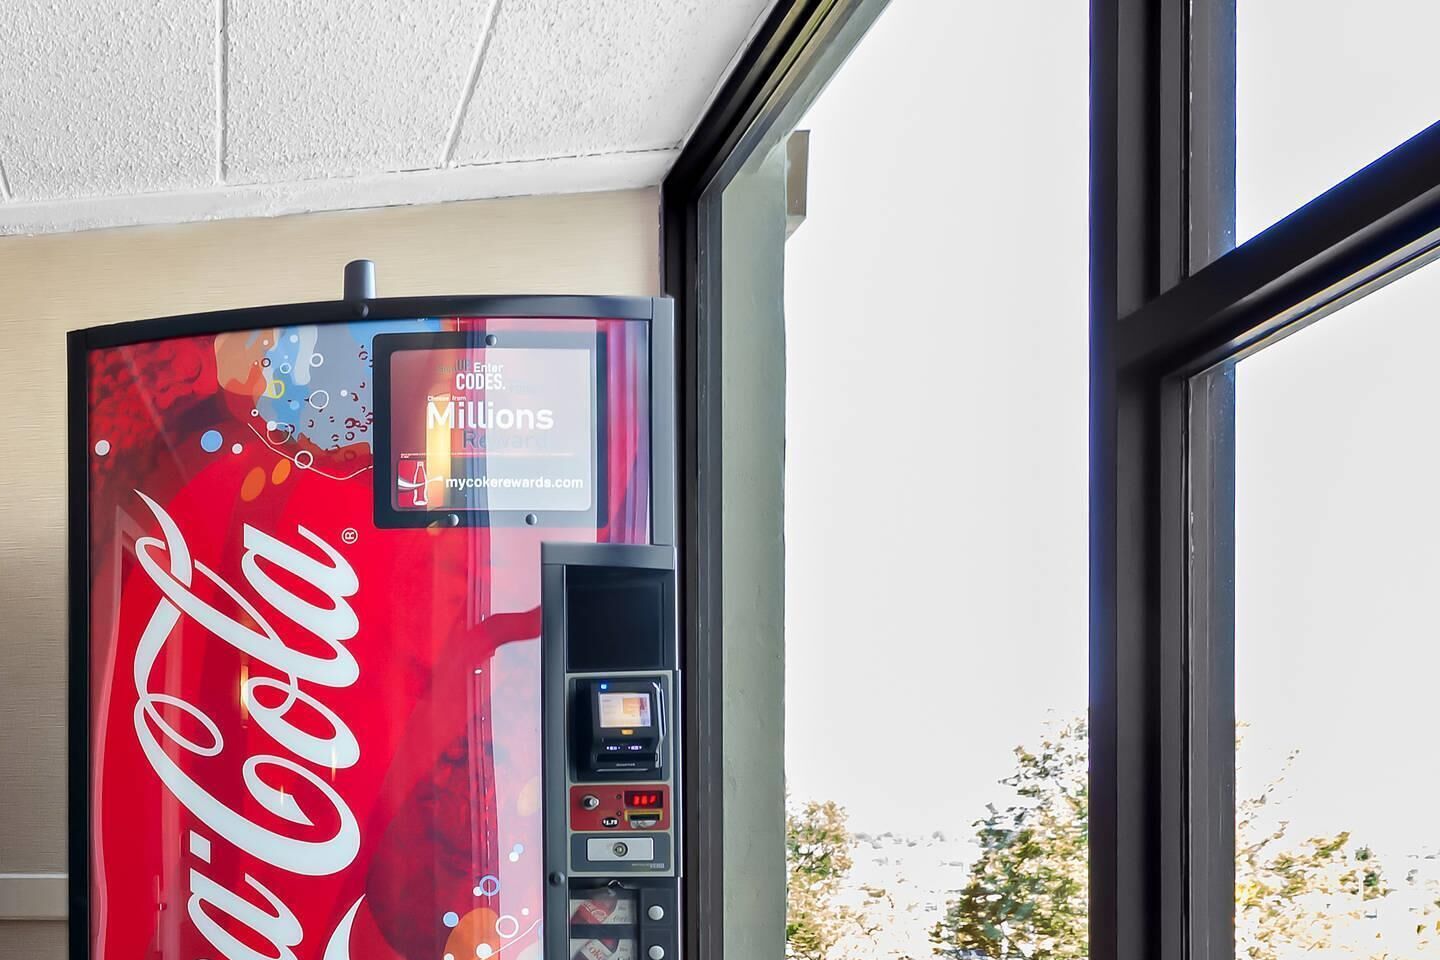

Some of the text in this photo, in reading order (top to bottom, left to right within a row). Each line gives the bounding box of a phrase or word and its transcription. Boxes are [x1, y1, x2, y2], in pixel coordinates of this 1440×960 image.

[473, 361, 504, 373] Enter
[456, 373, 506, 390] CODES.
[427, 400, 554, 430] Millions
[445, 475, 584, 490] mycokerewards.com
